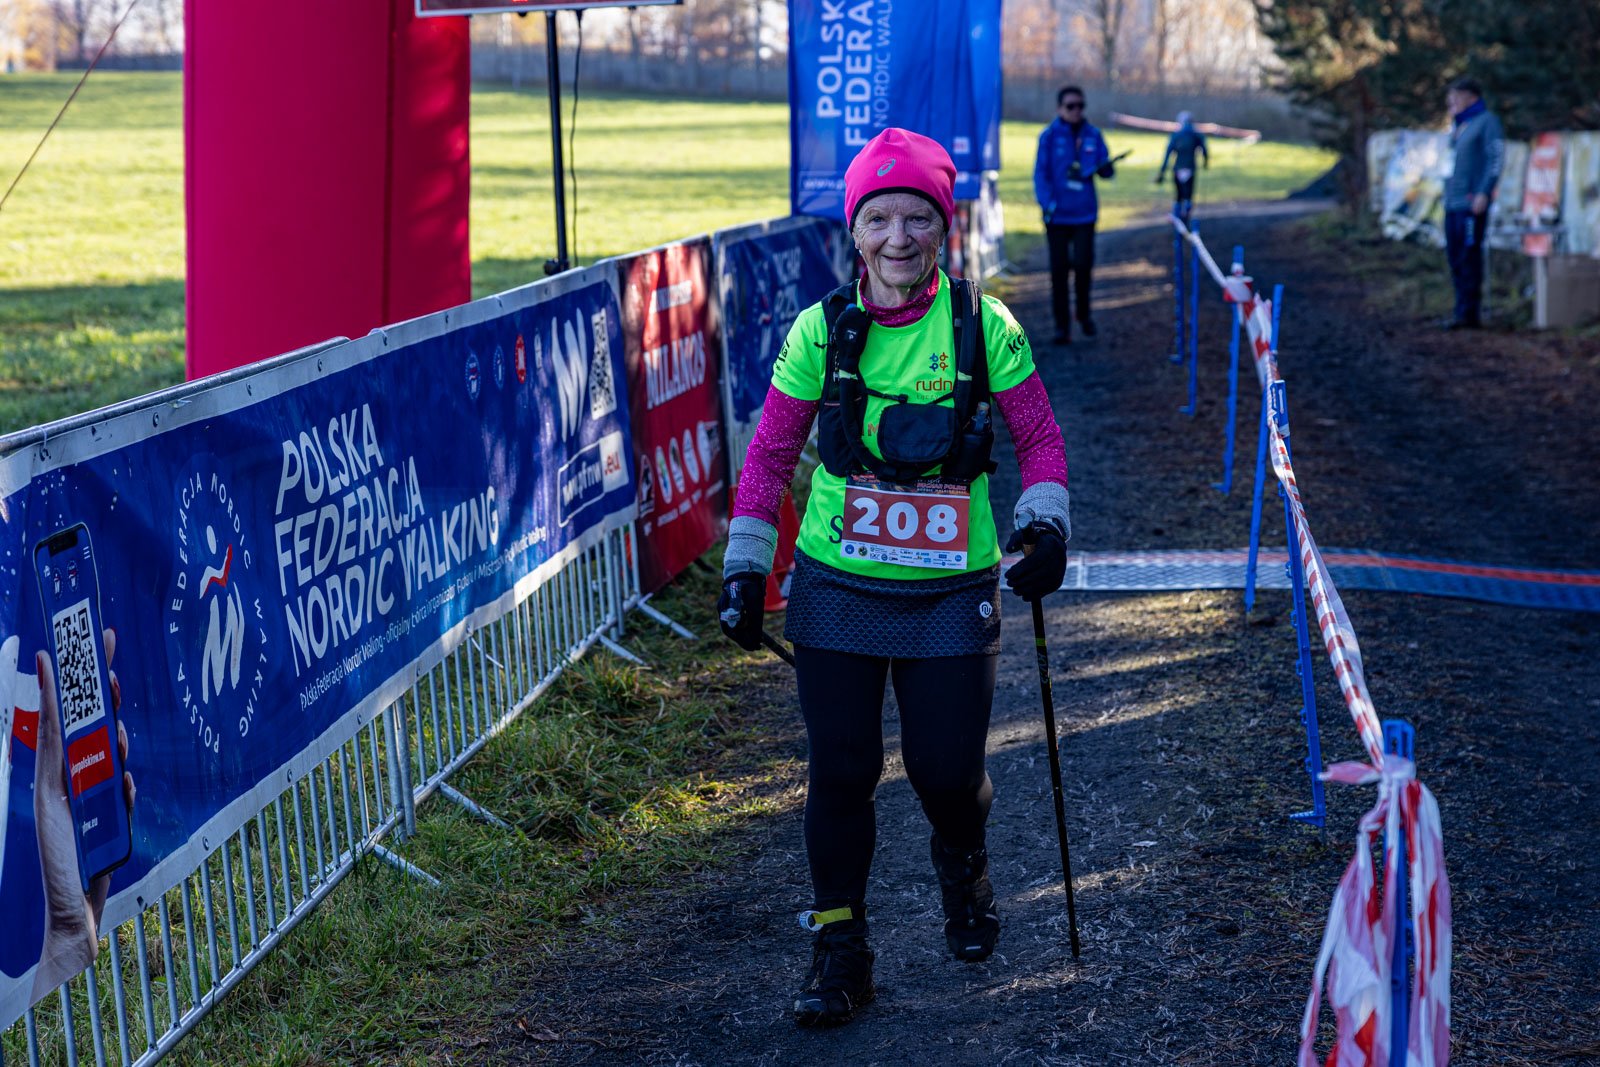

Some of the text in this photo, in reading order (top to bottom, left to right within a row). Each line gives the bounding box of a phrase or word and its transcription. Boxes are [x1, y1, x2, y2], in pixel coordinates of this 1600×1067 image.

[873, 52, 891, 128] NORDIC
[275, 402, 384, 516] POLSKA
[852, 497, 958, 543] 208
[274, 455, 426, 597] FEDERACJA
[285, 485, 499, 678] NORDIC WALKING
[170, 472, 268, 753] POLSKA FEDERACJA NORDIC WALKING
